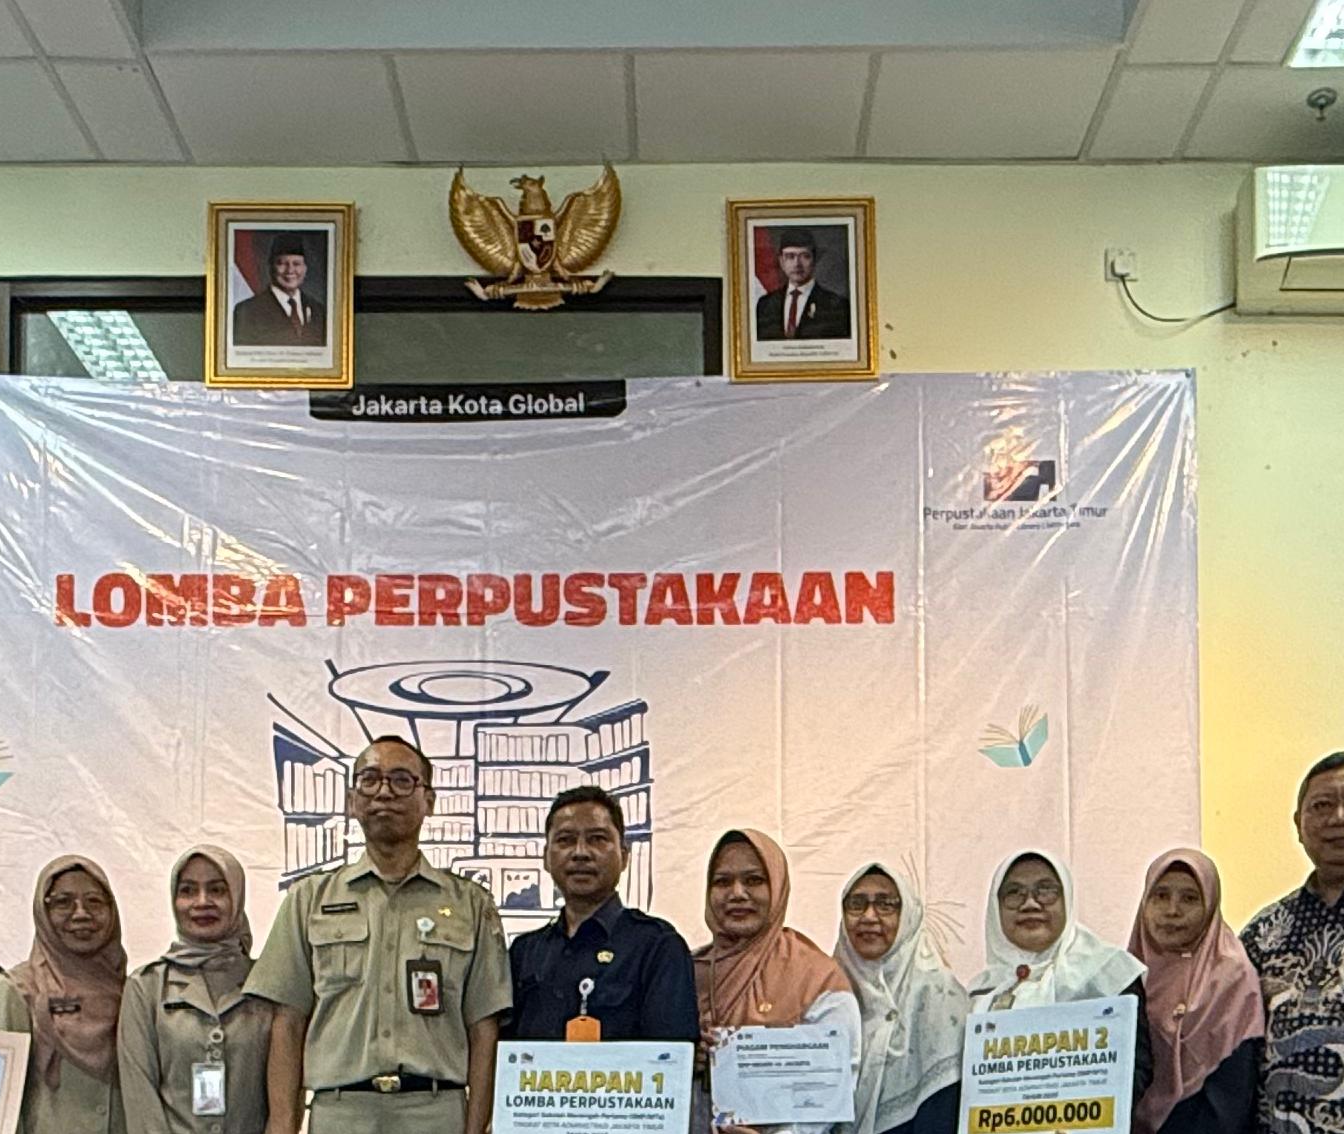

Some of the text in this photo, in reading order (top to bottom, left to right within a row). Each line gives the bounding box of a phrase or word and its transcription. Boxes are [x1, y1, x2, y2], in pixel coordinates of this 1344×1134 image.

[352, 391, 584, 416] Jakarta Kota Global
[55, 570, 896, 627] LOMBA PERPUSTAKAAN
[983, 1028, 1089, 1060] HARAPAN
[971, 1051, 1118, 1076] LOMBA PERPUSTAKAAN
[519, 1070, 665, 1094] HARAPAN 1
[505, 1095, 675, 1109] LOMBA PERPUSTAKAAN
[978, 1101, 1102, 1132] Rp6.000.000
